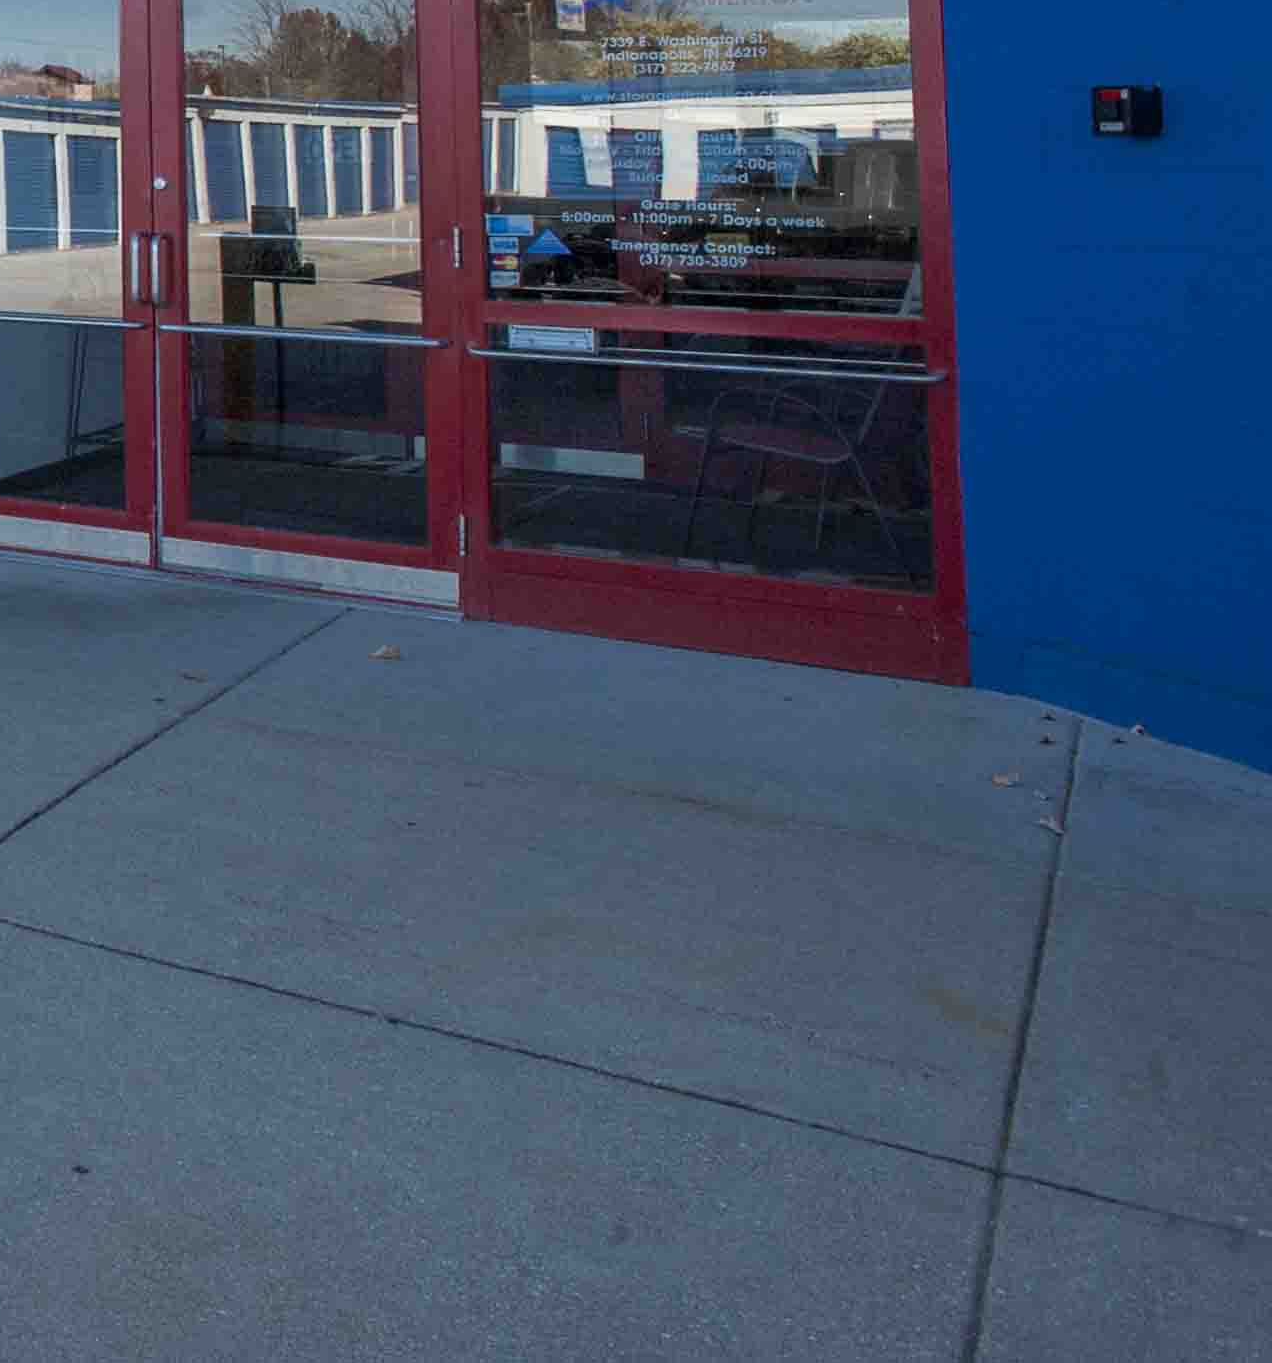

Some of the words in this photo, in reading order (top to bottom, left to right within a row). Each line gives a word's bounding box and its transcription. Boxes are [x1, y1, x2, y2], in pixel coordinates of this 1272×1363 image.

[633, 213, 693, 226] 11:00pm
[723, 214, 760, 228] Days
[783, 215, 825, 229] week
[611, 239, 698, 255] Emergency
[705, 240, 777, 256] Contact:
[640, 254, 673, 267] (317)
